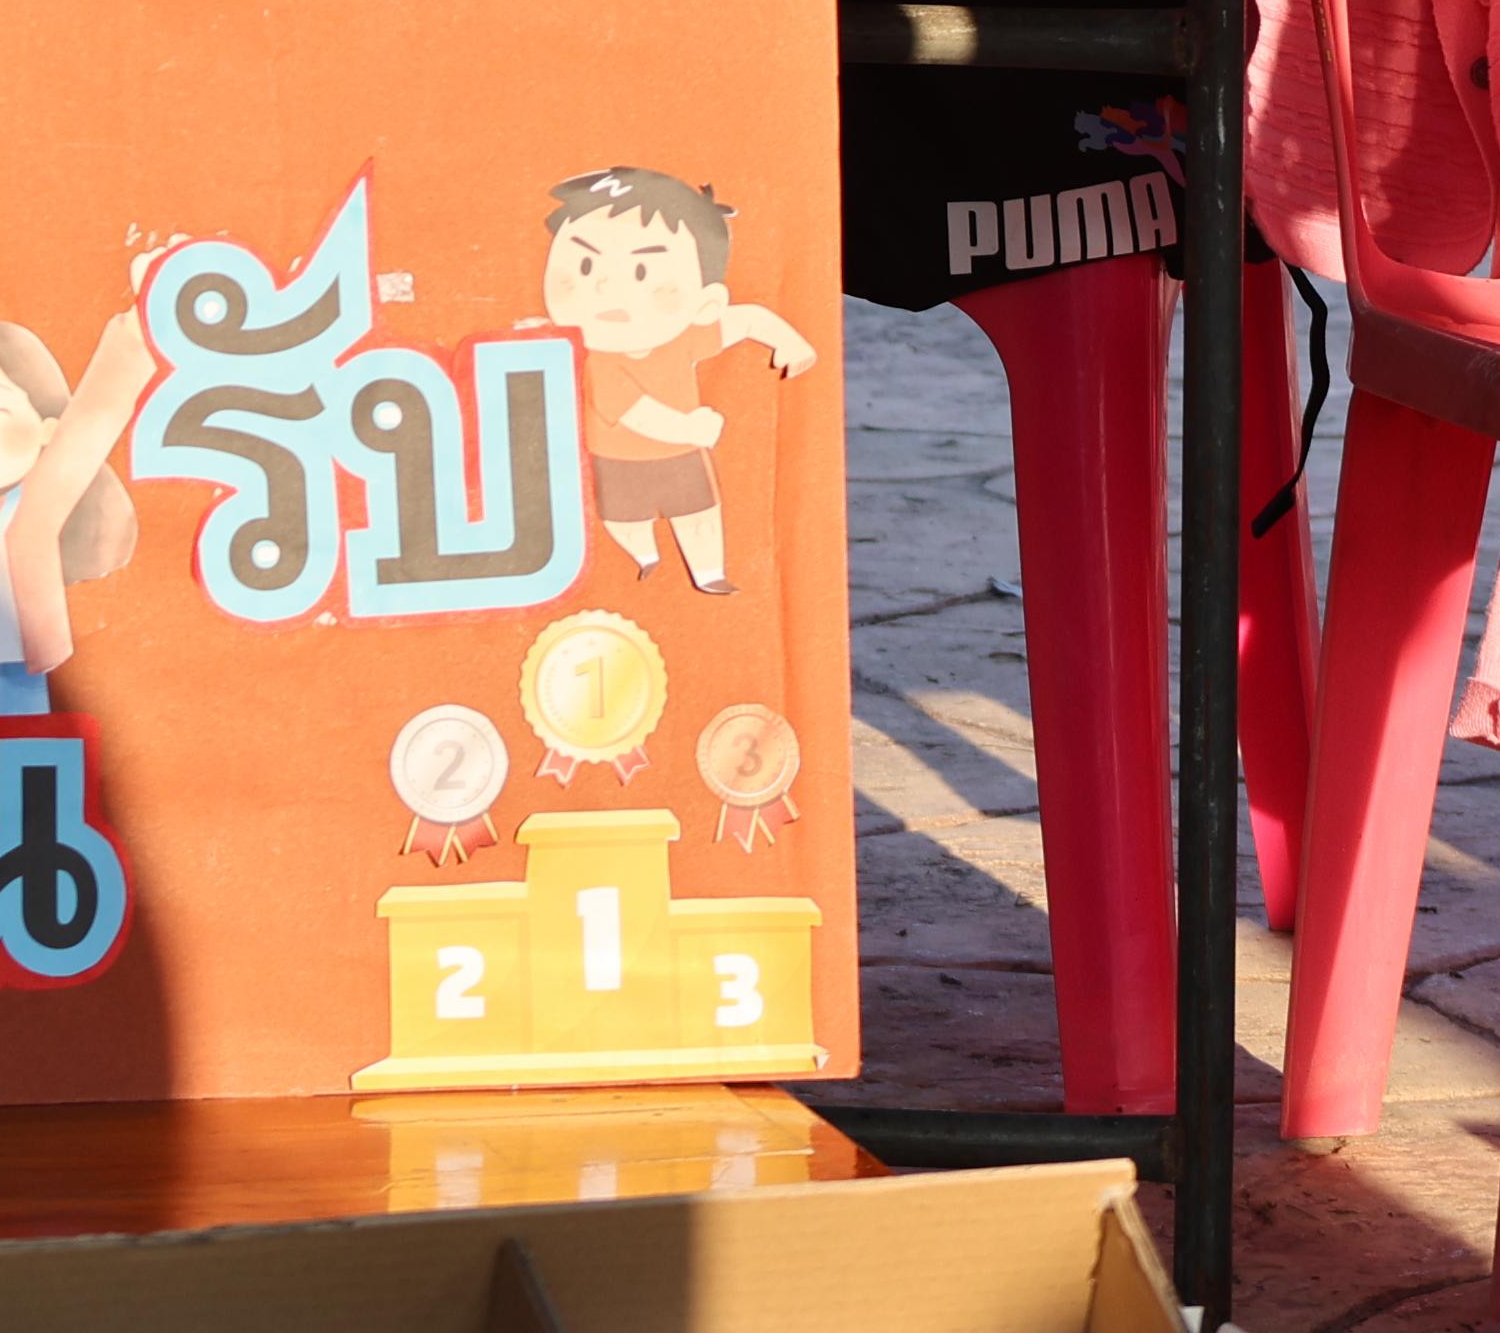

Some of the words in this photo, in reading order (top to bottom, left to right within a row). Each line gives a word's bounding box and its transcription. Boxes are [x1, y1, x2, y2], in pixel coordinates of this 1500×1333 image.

[946, 170, 1178, 276] PUMA
[145, 198, 570, 608] รับ
[574, 655, 606, 720] 1
[432, 739, 468, 792] 2
[732, 733, 765, 779] 3
[435, 945, 486, 1019] 2
[576, 886, 622, 991] 1
[712, 953, 766, 1027] 3
